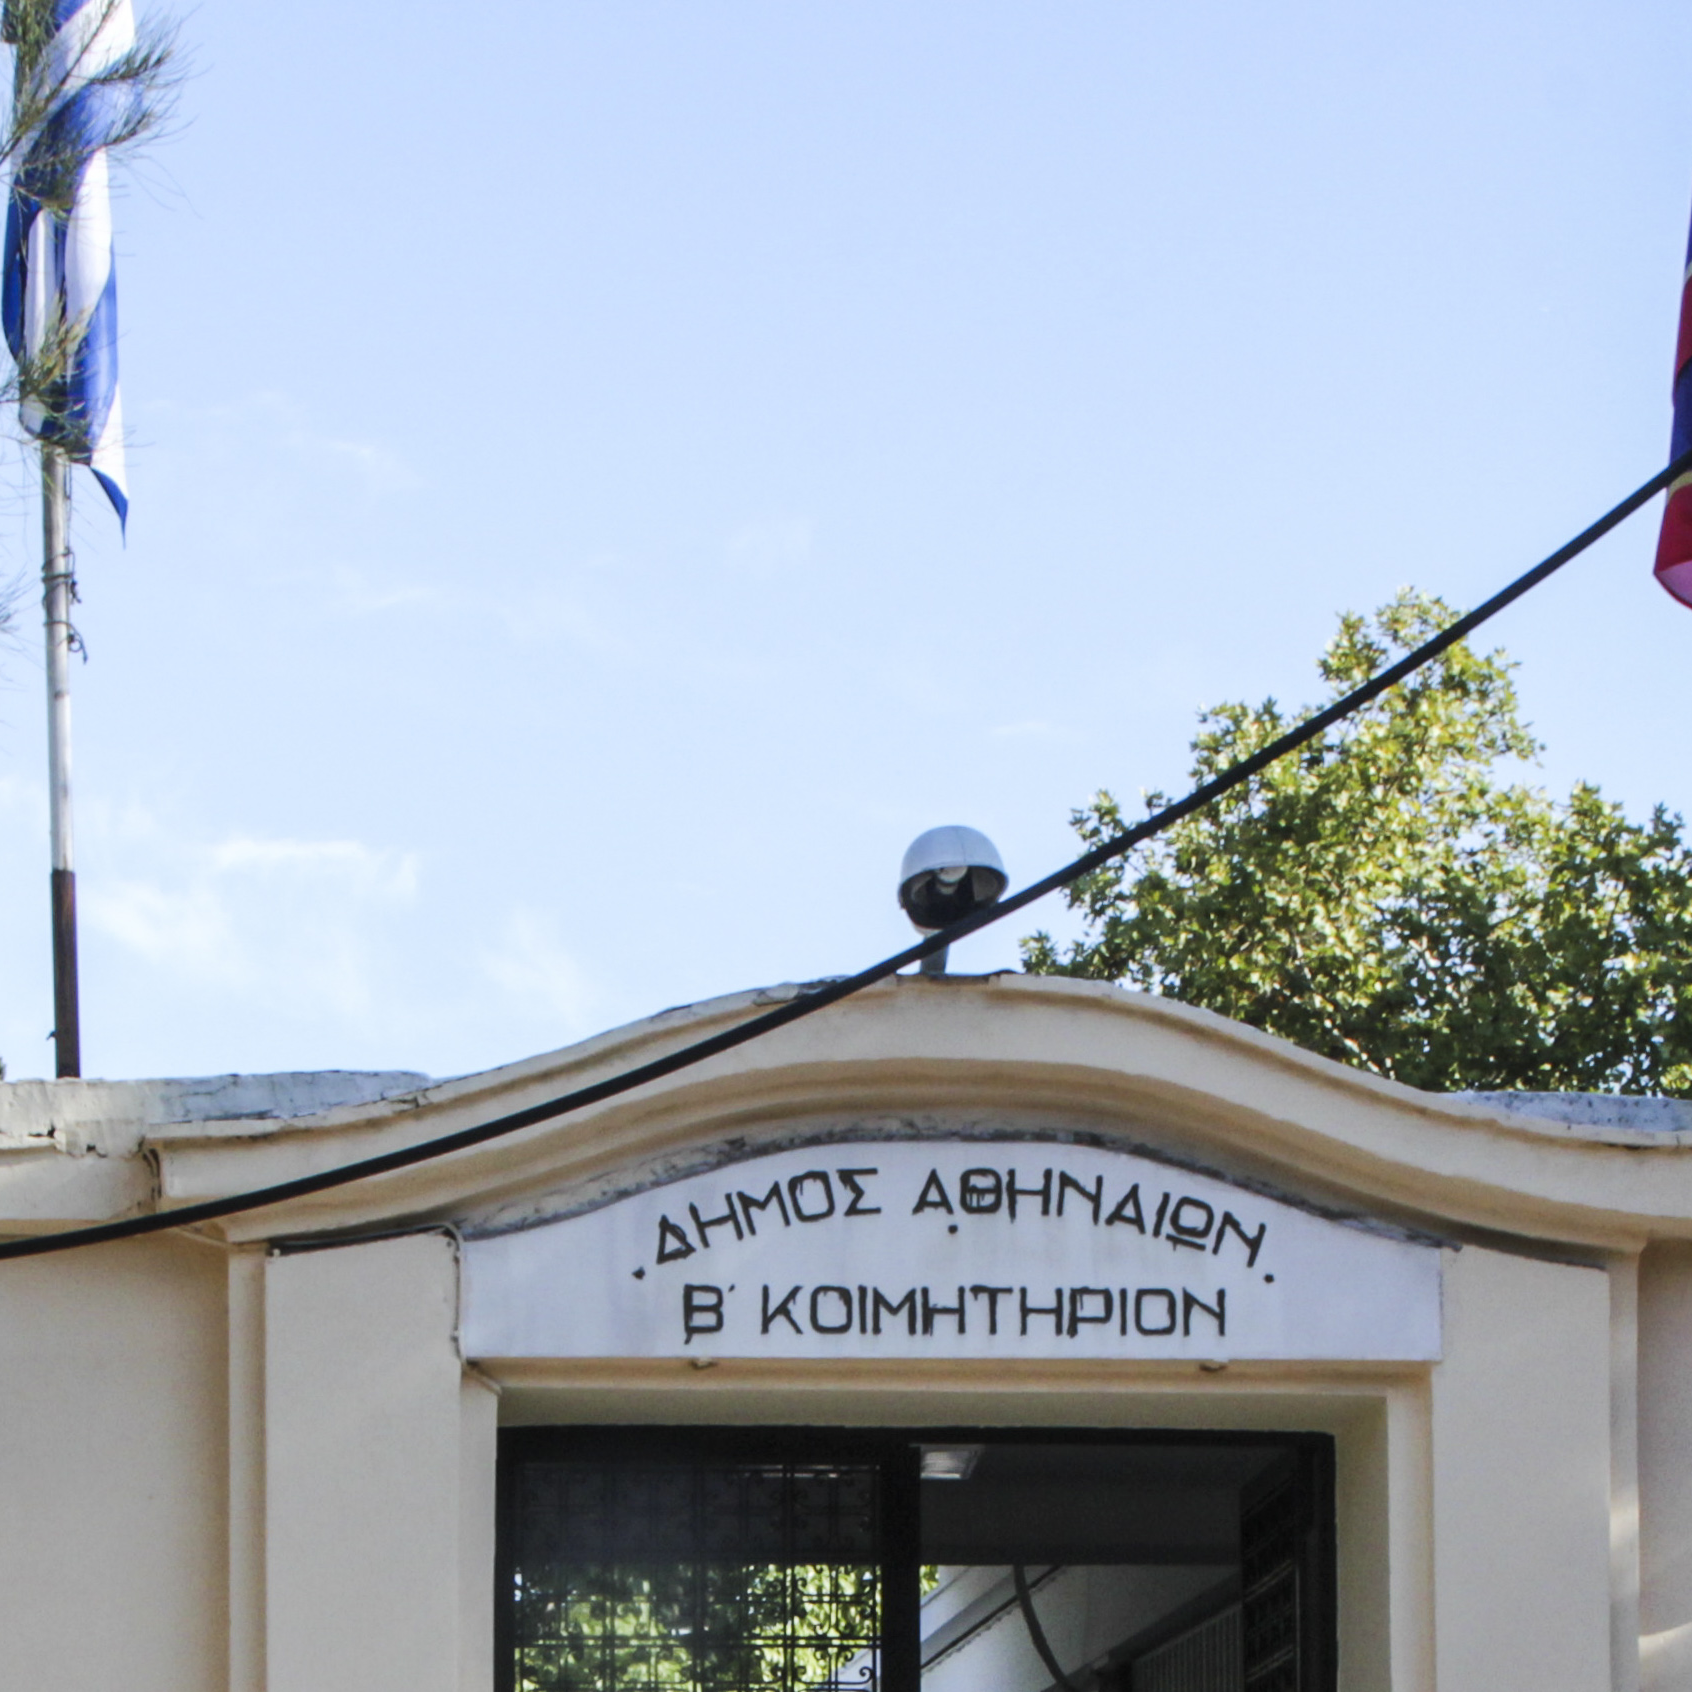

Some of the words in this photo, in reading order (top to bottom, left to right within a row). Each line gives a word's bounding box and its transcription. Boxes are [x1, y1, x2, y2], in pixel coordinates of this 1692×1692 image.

[655, 1167, 882, 1265] ΔΗΜΟΣ
[911, 1167, 1267, 1268] ΑΘΗΝΑΙΩΝ
[760, 1283, 1226, 1339] ΚΟΙΜΗΤΗΡΙΟΝ
